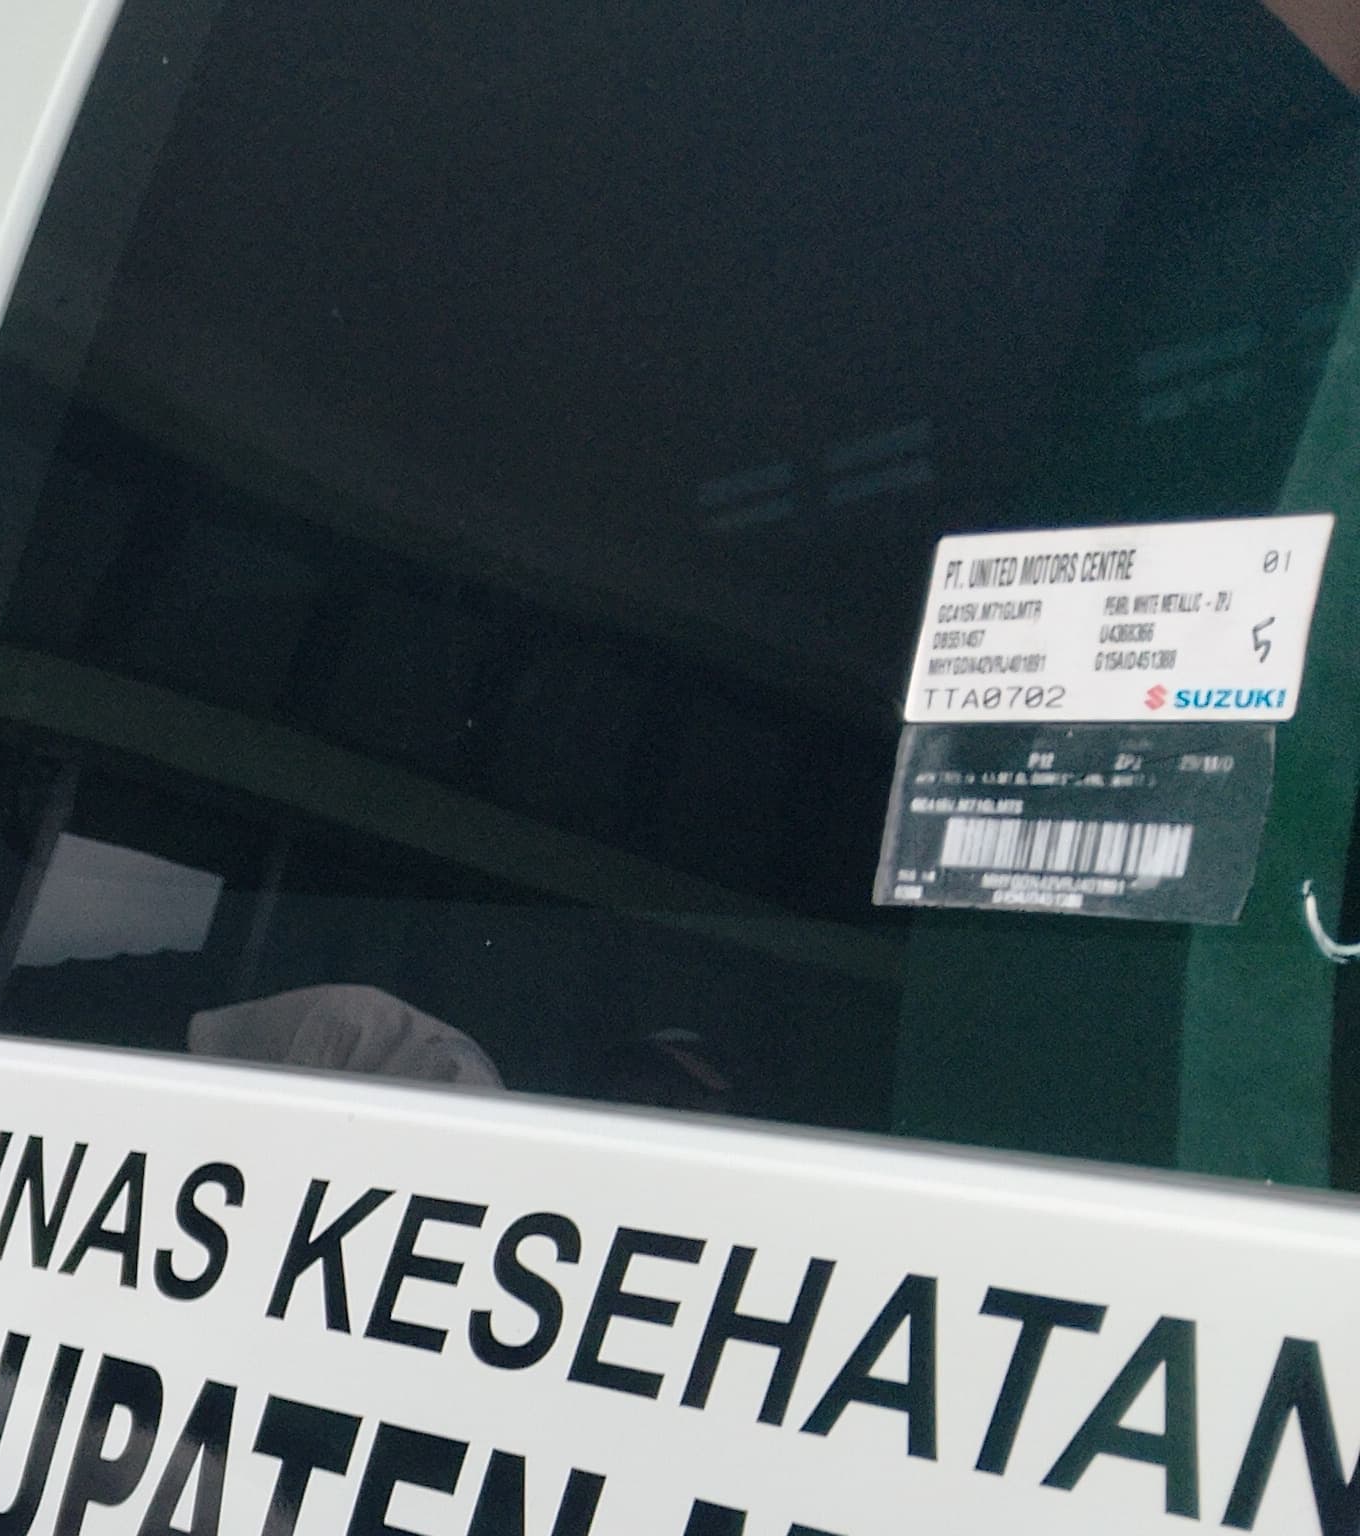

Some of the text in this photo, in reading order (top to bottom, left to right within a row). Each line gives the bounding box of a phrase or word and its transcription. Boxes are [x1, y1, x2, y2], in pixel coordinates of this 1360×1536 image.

[944, 549, 1138, 590] PT. UNITED MOTORS CENTRE
[1262, 549, 1293, 574] 01
[1133, 594, 1160, 615] WHITE
[1160, 592, 1203, 614] METALLIC
[1251, 616, 1276, 663] 5
[923, 685, 1067, 710] TTA0702
[1173, 688, 1288, 709] SUZUKI
